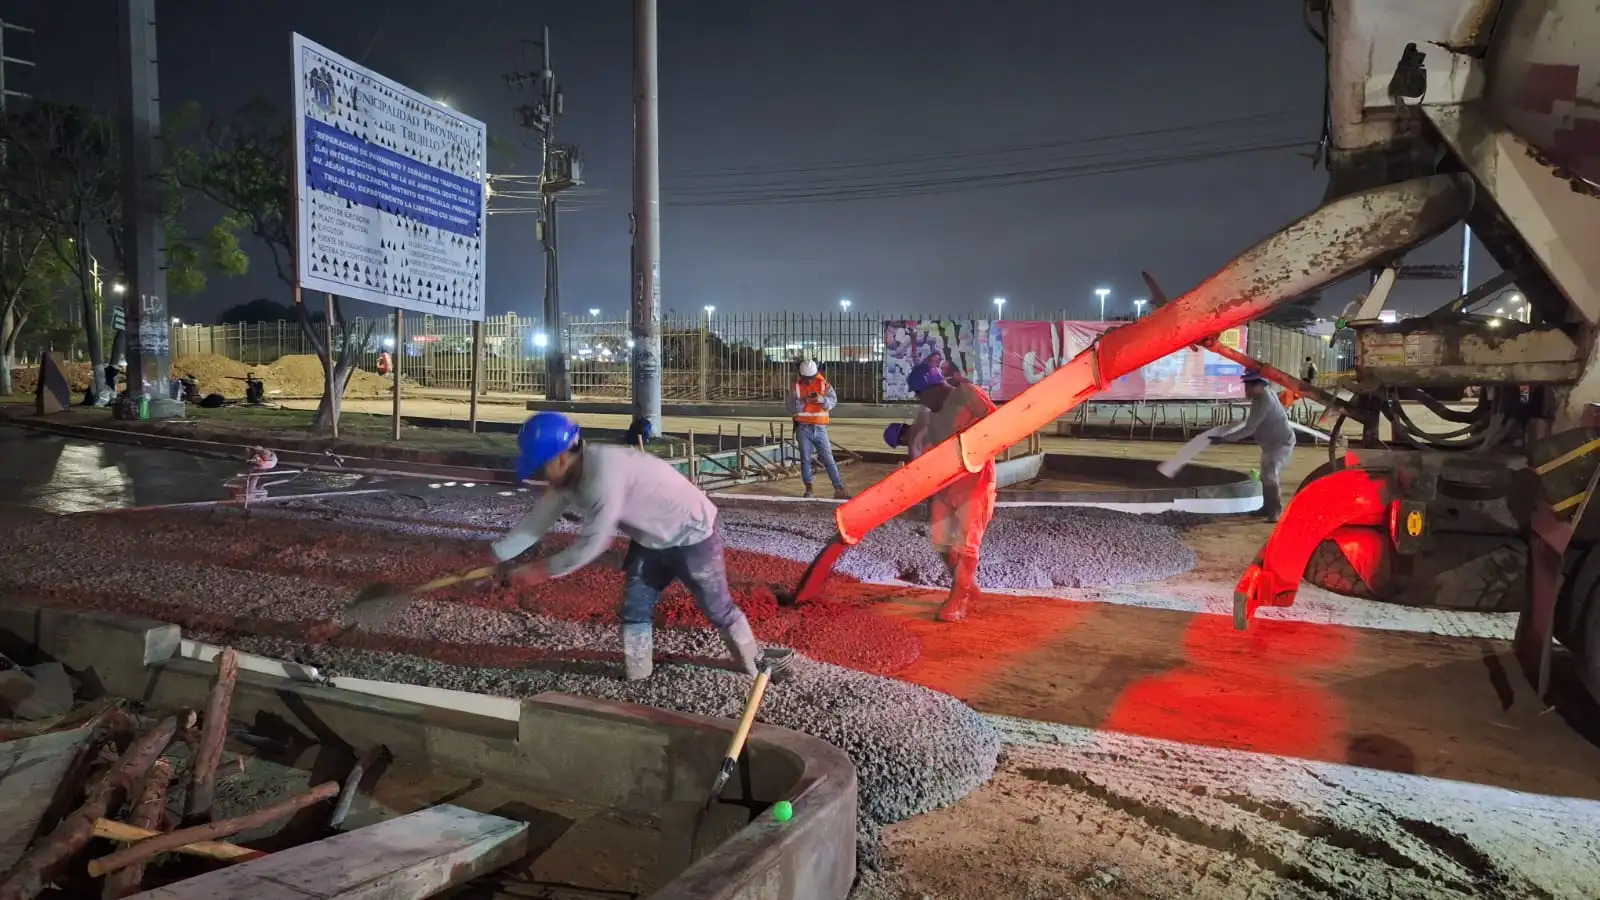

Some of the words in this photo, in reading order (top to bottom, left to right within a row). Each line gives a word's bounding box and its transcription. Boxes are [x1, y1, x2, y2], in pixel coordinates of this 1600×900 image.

[342, 82, 419, 126] MUNICIPALIDAD
[424, 119, 470, 148] PROVINCIAL
[385, 120, 395, 134] DE
[401, 125, 439, 152] TRUJILLO
[347, 167, 355, 177] DE
[360, 147, 367, 157] DE
[369, 151, 400, 169] PAVIMENTO
[402, 163, 405, 171] Y
[407, 165, 430, 180] SEÑALES
[377, 167, 389, 177] VIAL
[399, 175, 406, 183] LA
[323, 172, 356, 191] TRUJILLO,
[358, 184, 403, 206] DEPARTAMENTO
[404, 200, 411, 209] LA
